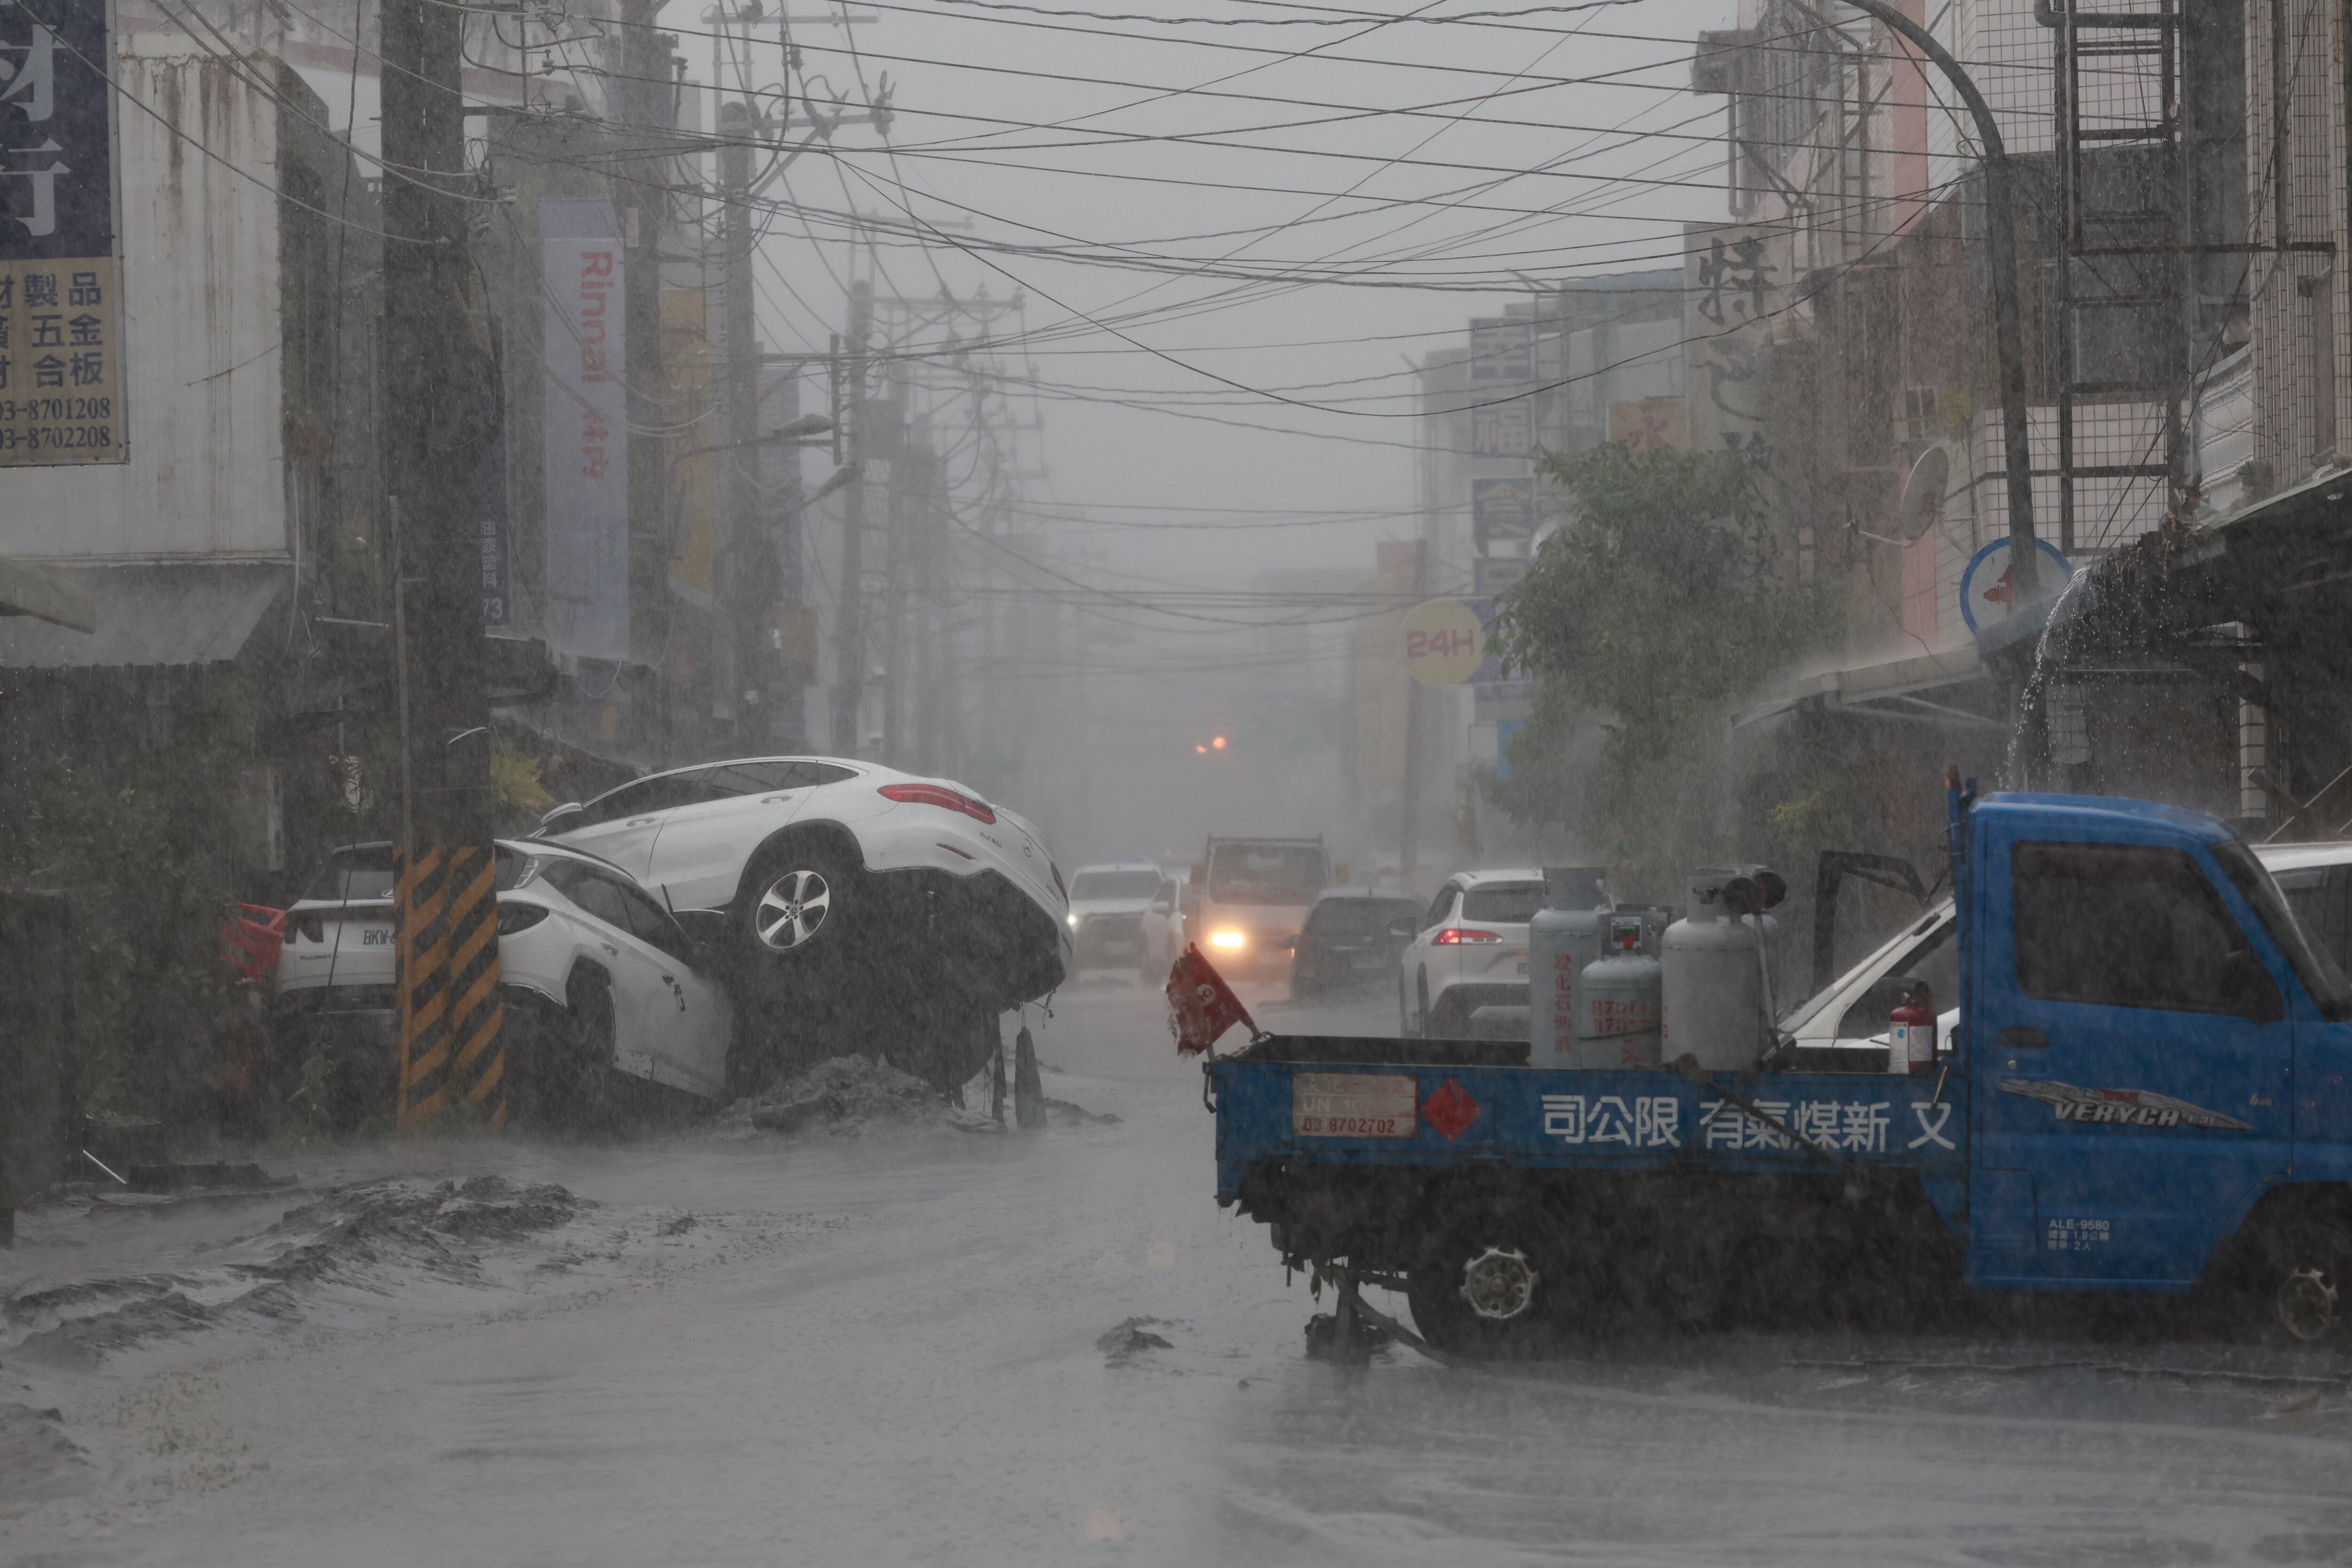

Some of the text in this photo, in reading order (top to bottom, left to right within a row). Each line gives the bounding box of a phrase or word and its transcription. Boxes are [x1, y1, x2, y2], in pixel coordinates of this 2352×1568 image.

[580, 251, 614, 383] Rinnai
[1407, 628, 1475, 659] 24H
[1303, 1097, 1330, 1113] UN
[2054, 1101, 2182, 1128] VERYCA
[1329, 1118, 1395, 1134] 8702702
[2049, 1218, 2110, 1231] ALE-9580
